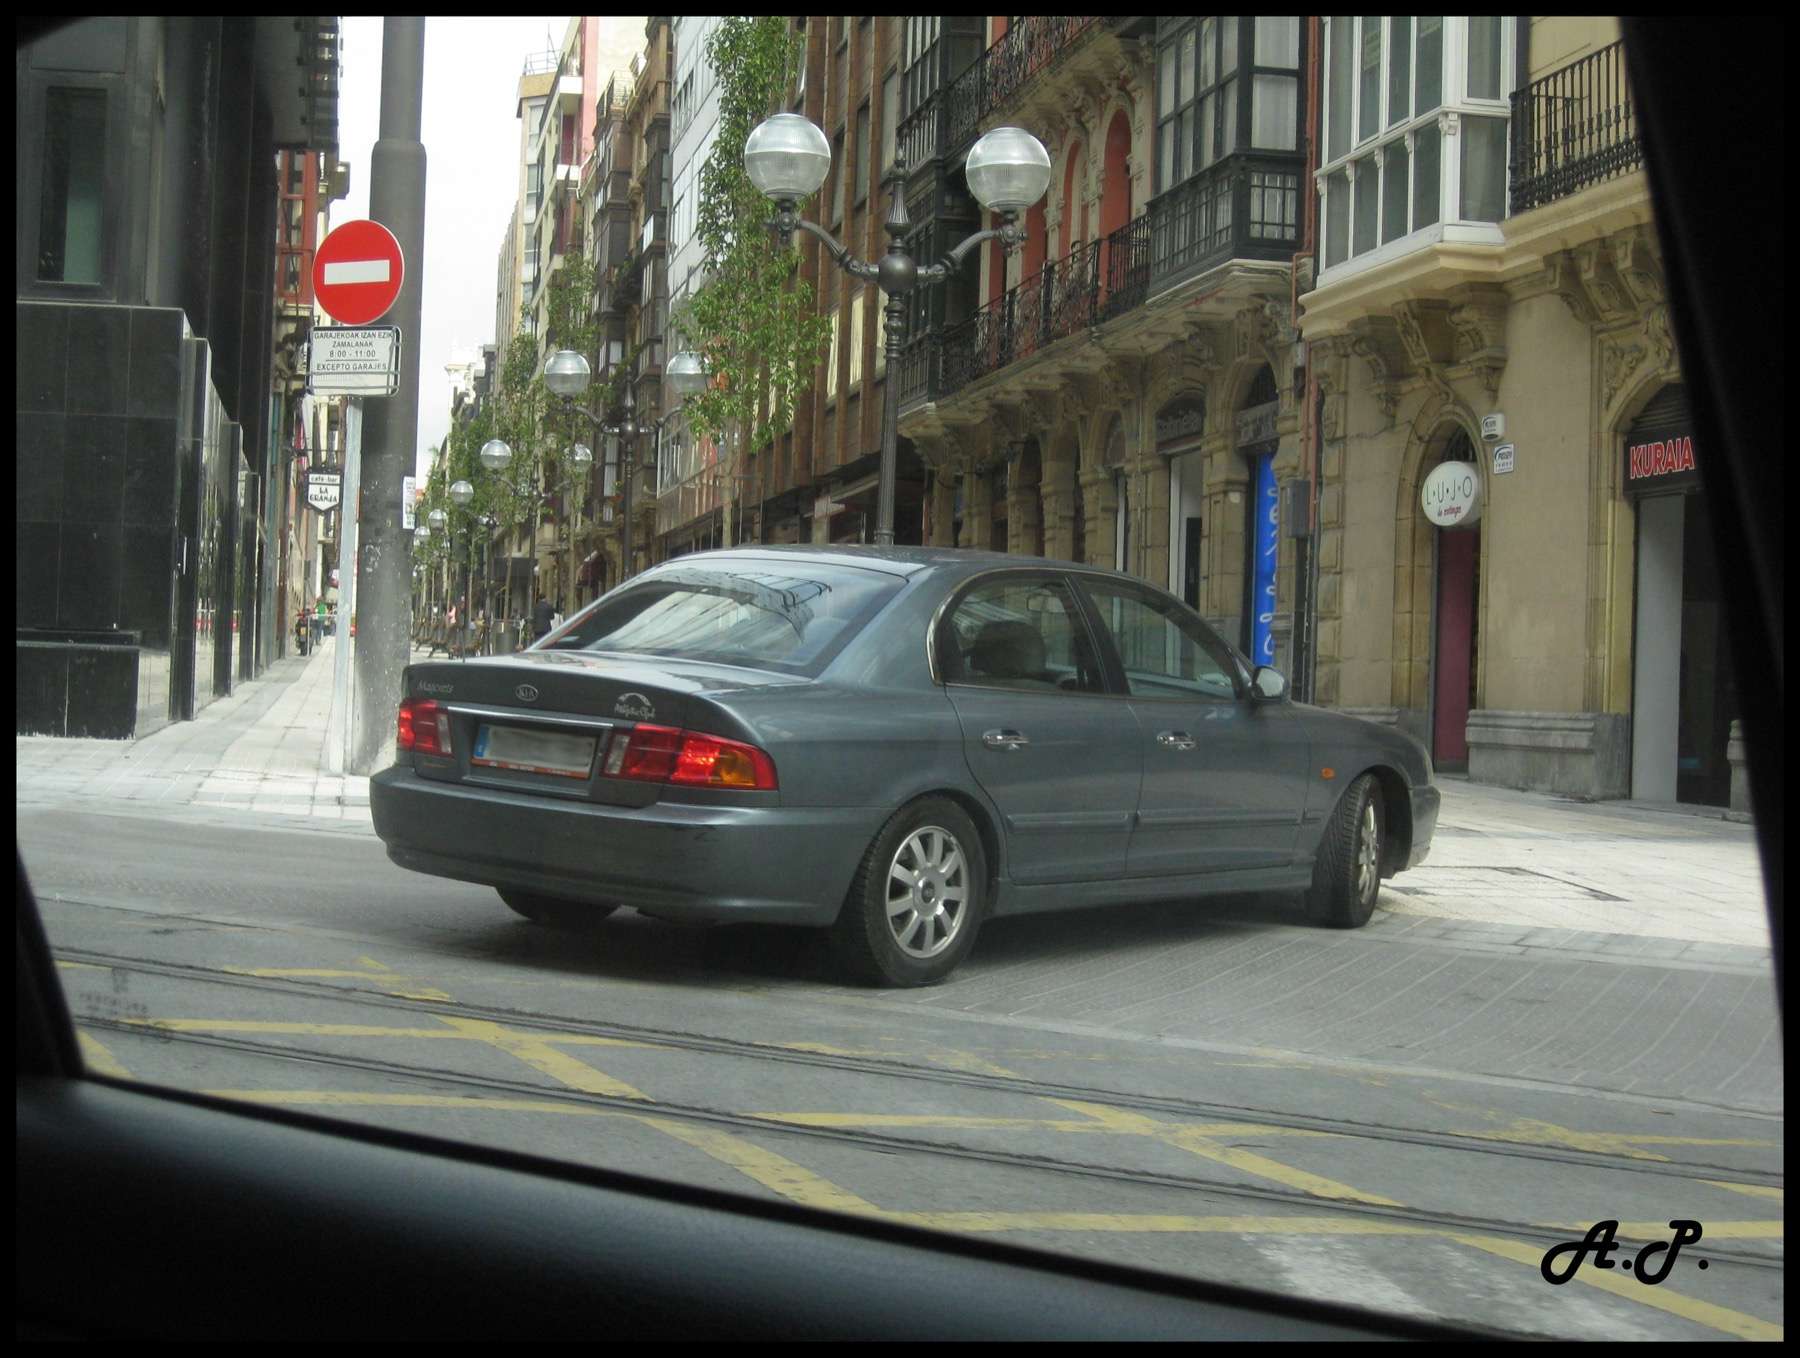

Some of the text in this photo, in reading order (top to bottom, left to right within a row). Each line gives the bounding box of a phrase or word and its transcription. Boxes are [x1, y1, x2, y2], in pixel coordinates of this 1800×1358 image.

[314, 332, 359, 340] GARAJEKOAK
[329, 350, 347, 358] 8:00
[355, 350, 376, 358] 11:00
[316, 362, 387, 371] EXCEPTO GARAJES
[1629, 436, 1695, 480] KURAIA
